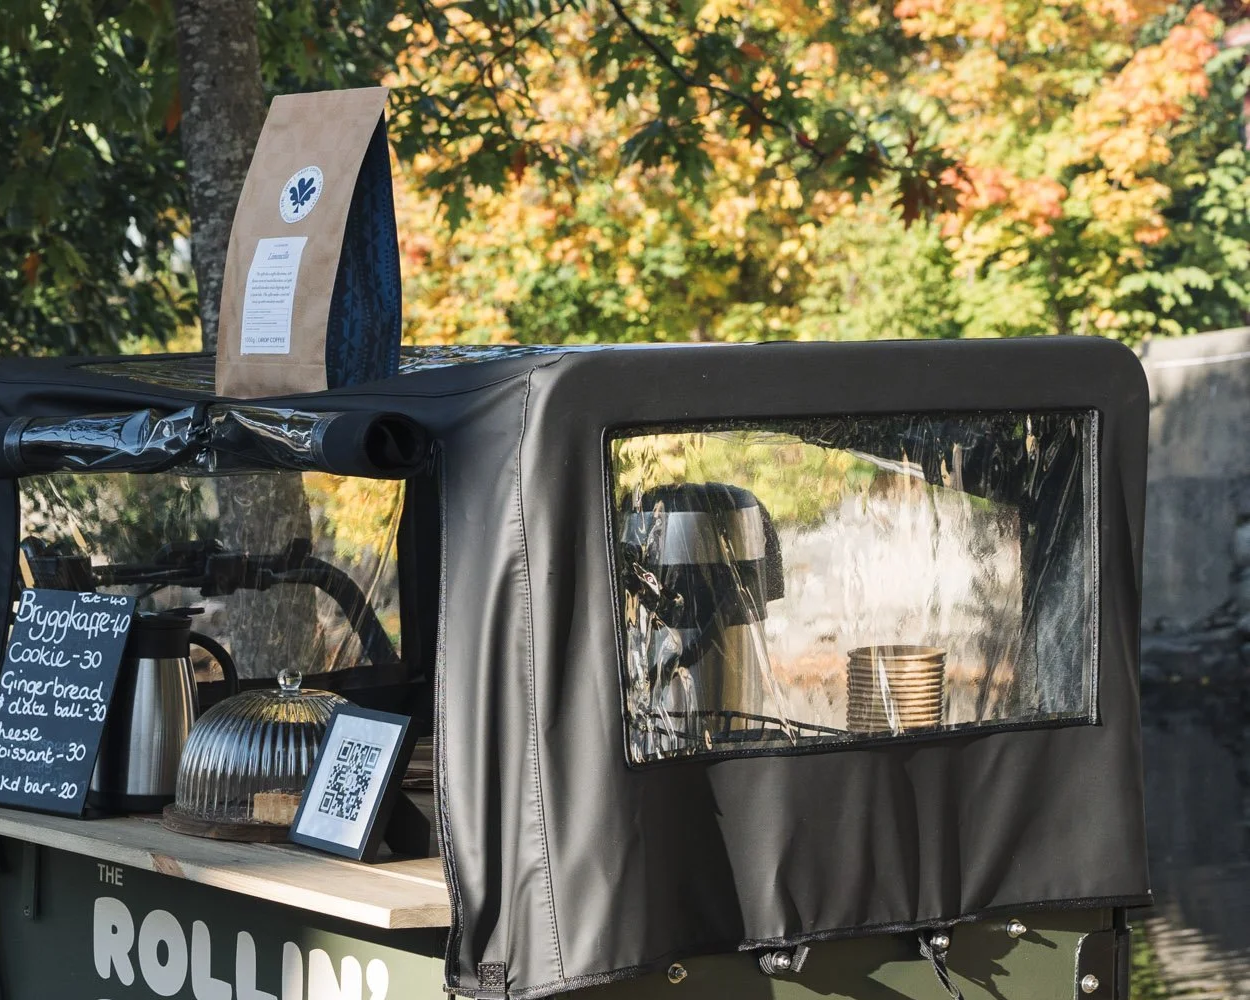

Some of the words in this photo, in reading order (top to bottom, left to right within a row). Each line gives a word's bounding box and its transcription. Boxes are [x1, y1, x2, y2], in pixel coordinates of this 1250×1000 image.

[1, 669, 104, 702] Gingerbread
[8, 697, 48, 716] date
[97, 864, 123, 886] THE
